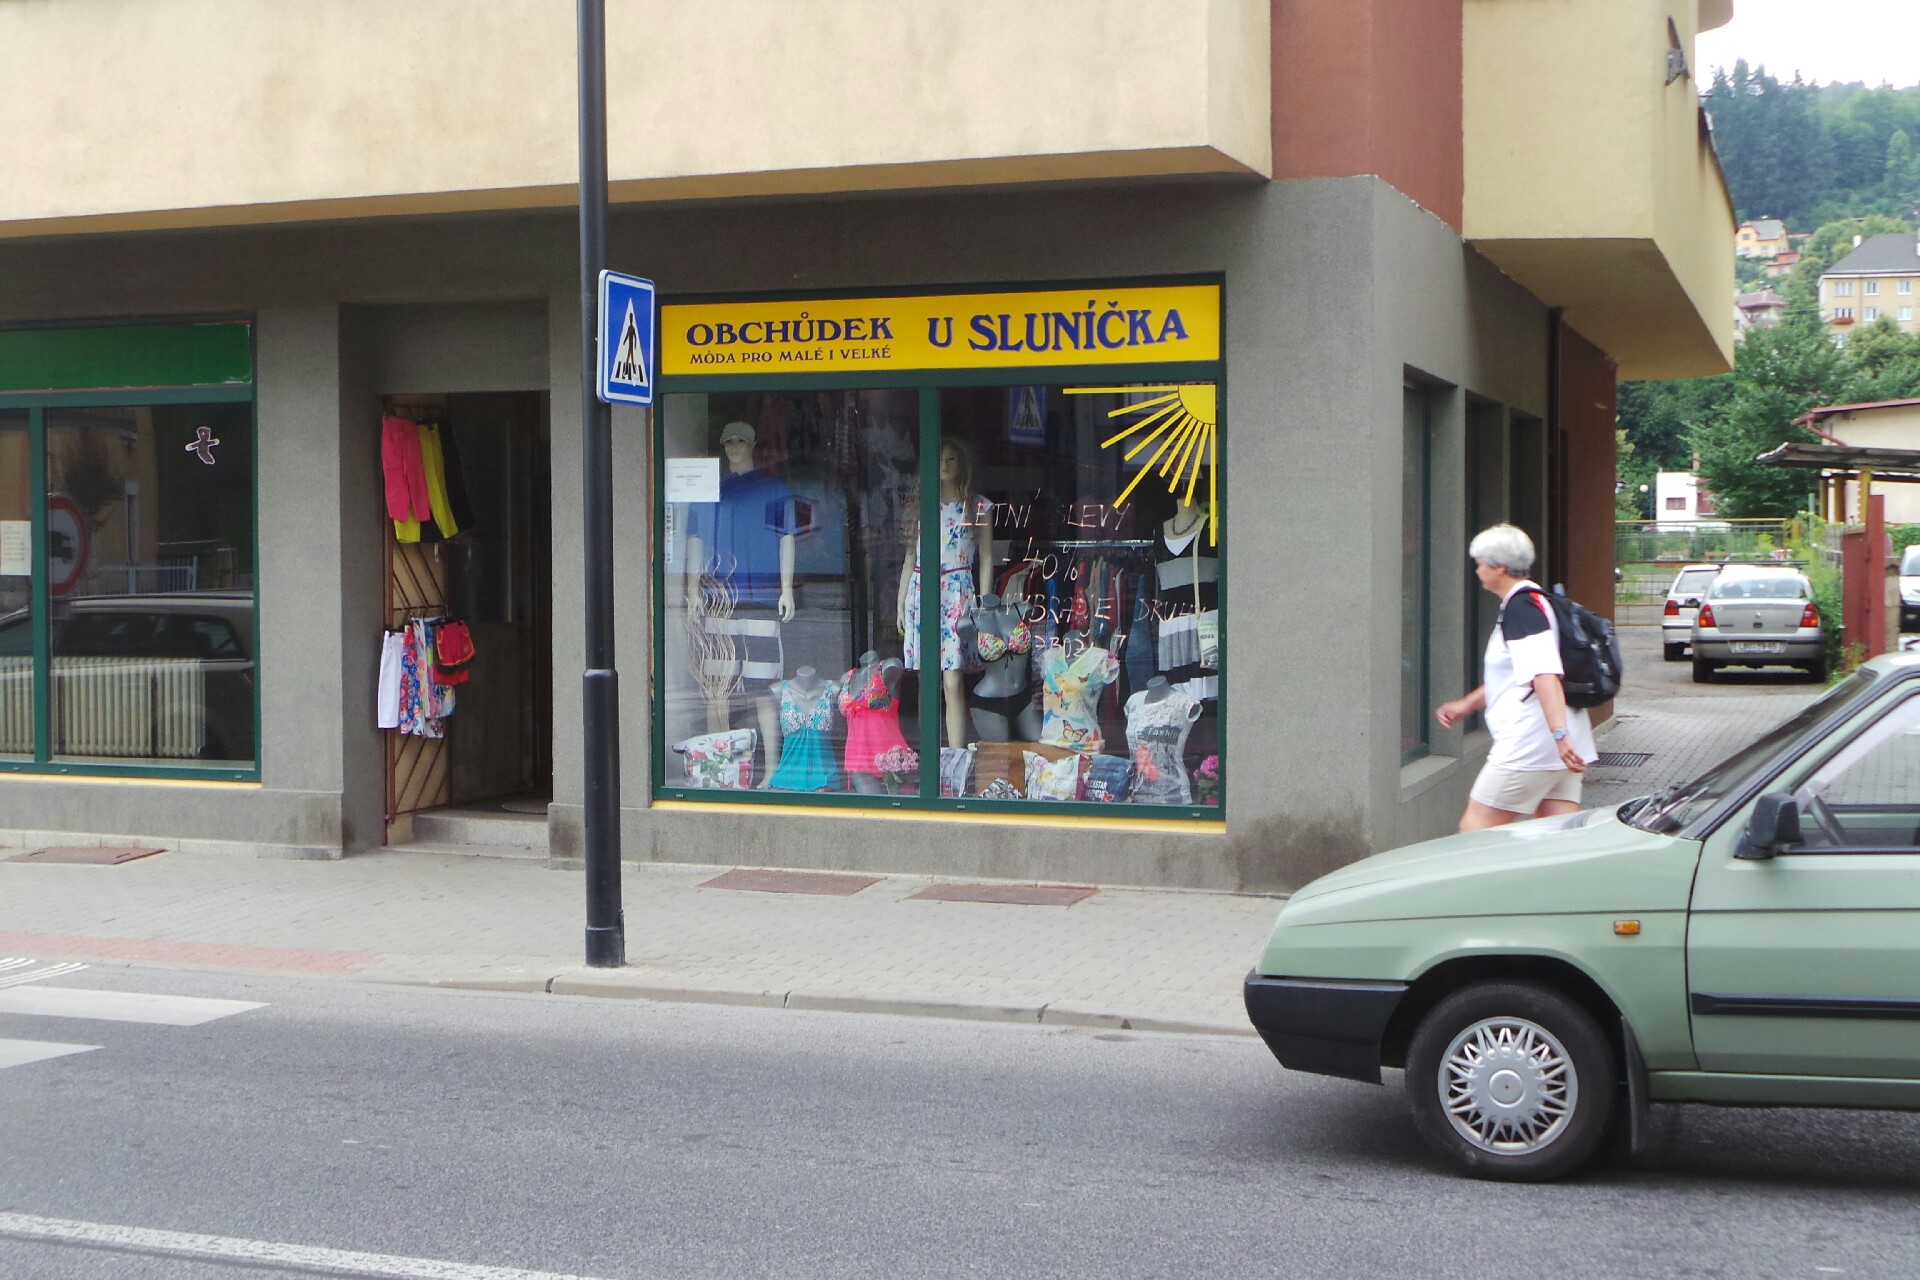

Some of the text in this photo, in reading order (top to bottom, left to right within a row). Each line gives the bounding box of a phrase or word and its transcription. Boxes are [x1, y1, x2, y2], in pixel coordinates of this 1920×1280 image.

[686, 299, 1190, 353] OBCHŮDEK U SLUNÍČKA
[689, 344, 892, 365] MÓDA PRO MALÉ I VELKÉ
[960, 487, 1041, 529] LETNÍ
